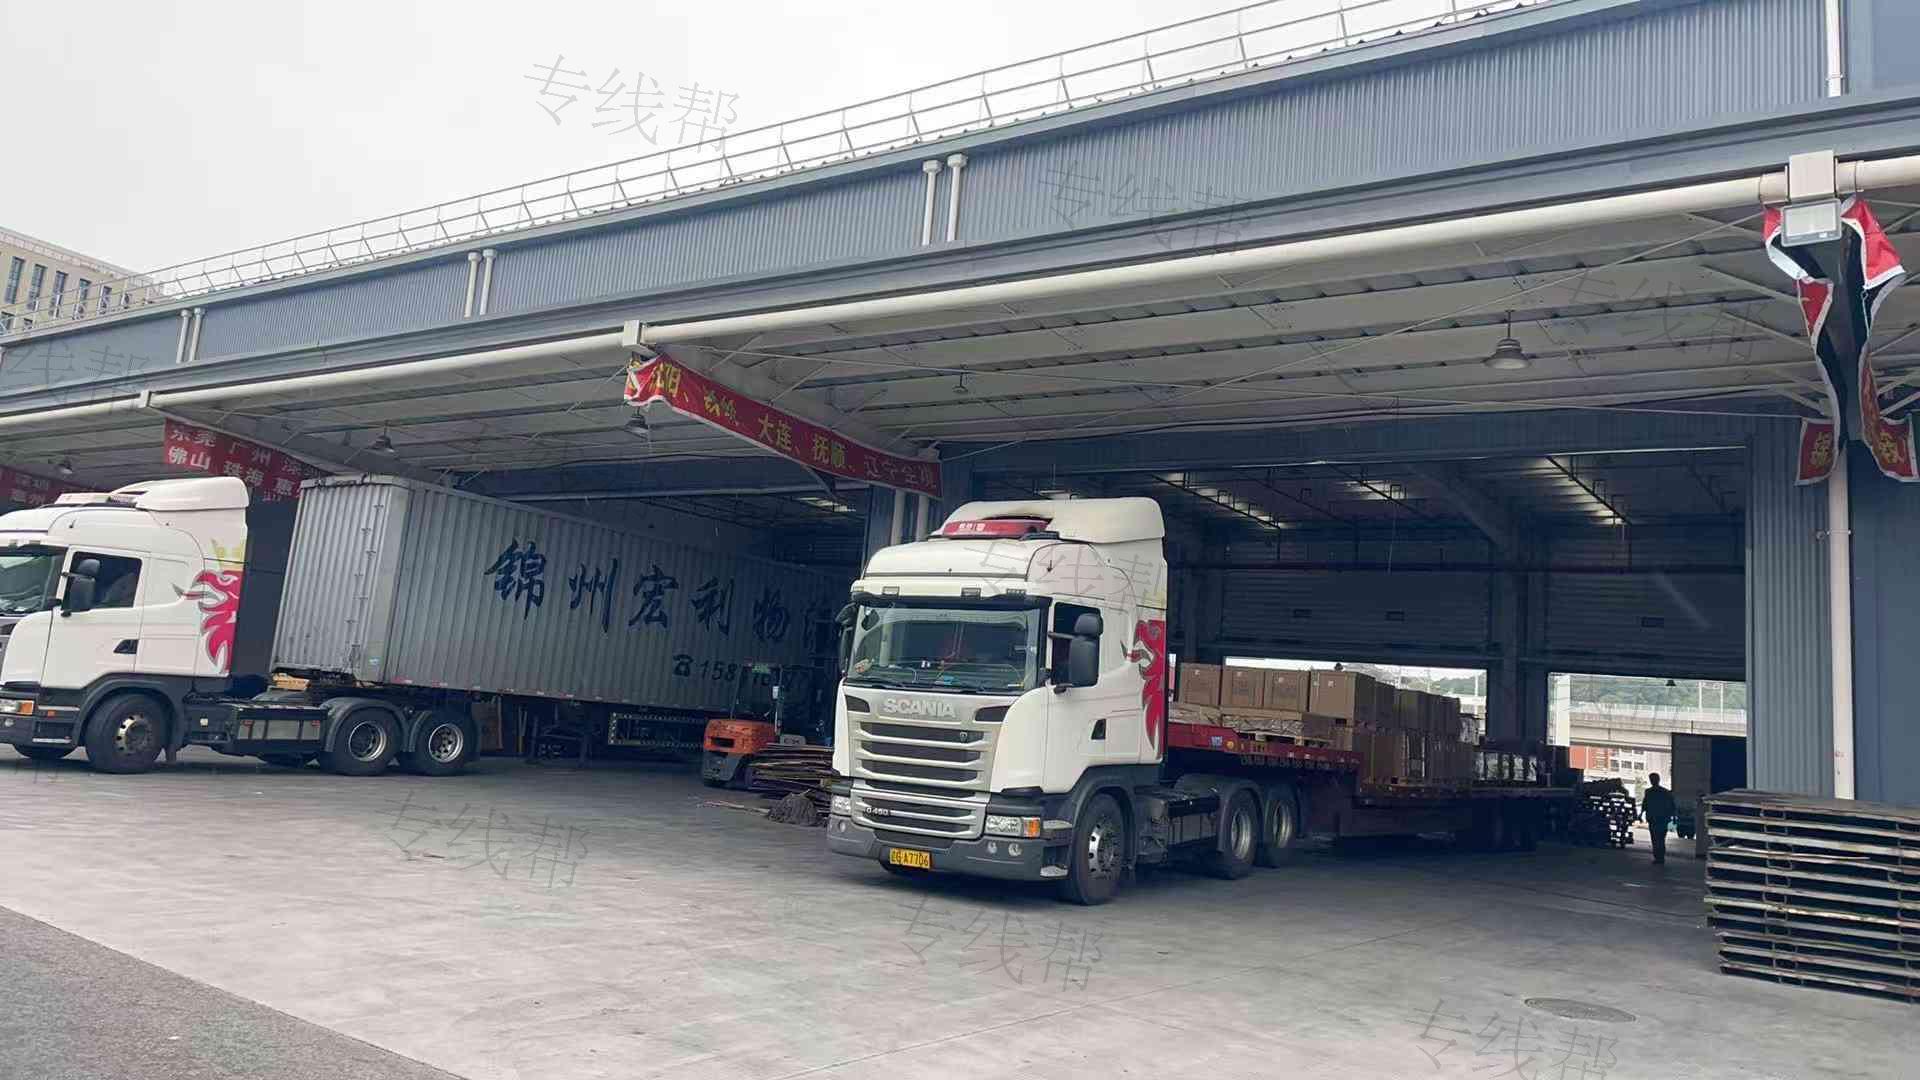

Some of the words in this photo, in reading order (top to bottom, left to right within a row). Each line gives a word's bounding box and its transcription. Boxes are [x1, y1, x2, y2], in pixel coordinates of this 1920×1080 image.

[229, 442, 272, 466] 广州
[168, 446, 212, 470] 佛山
[223, 460, 264, 486] 珠海
[273, 477, 301, 498] 惠
[883, 698, 956, 718] SCANIA
